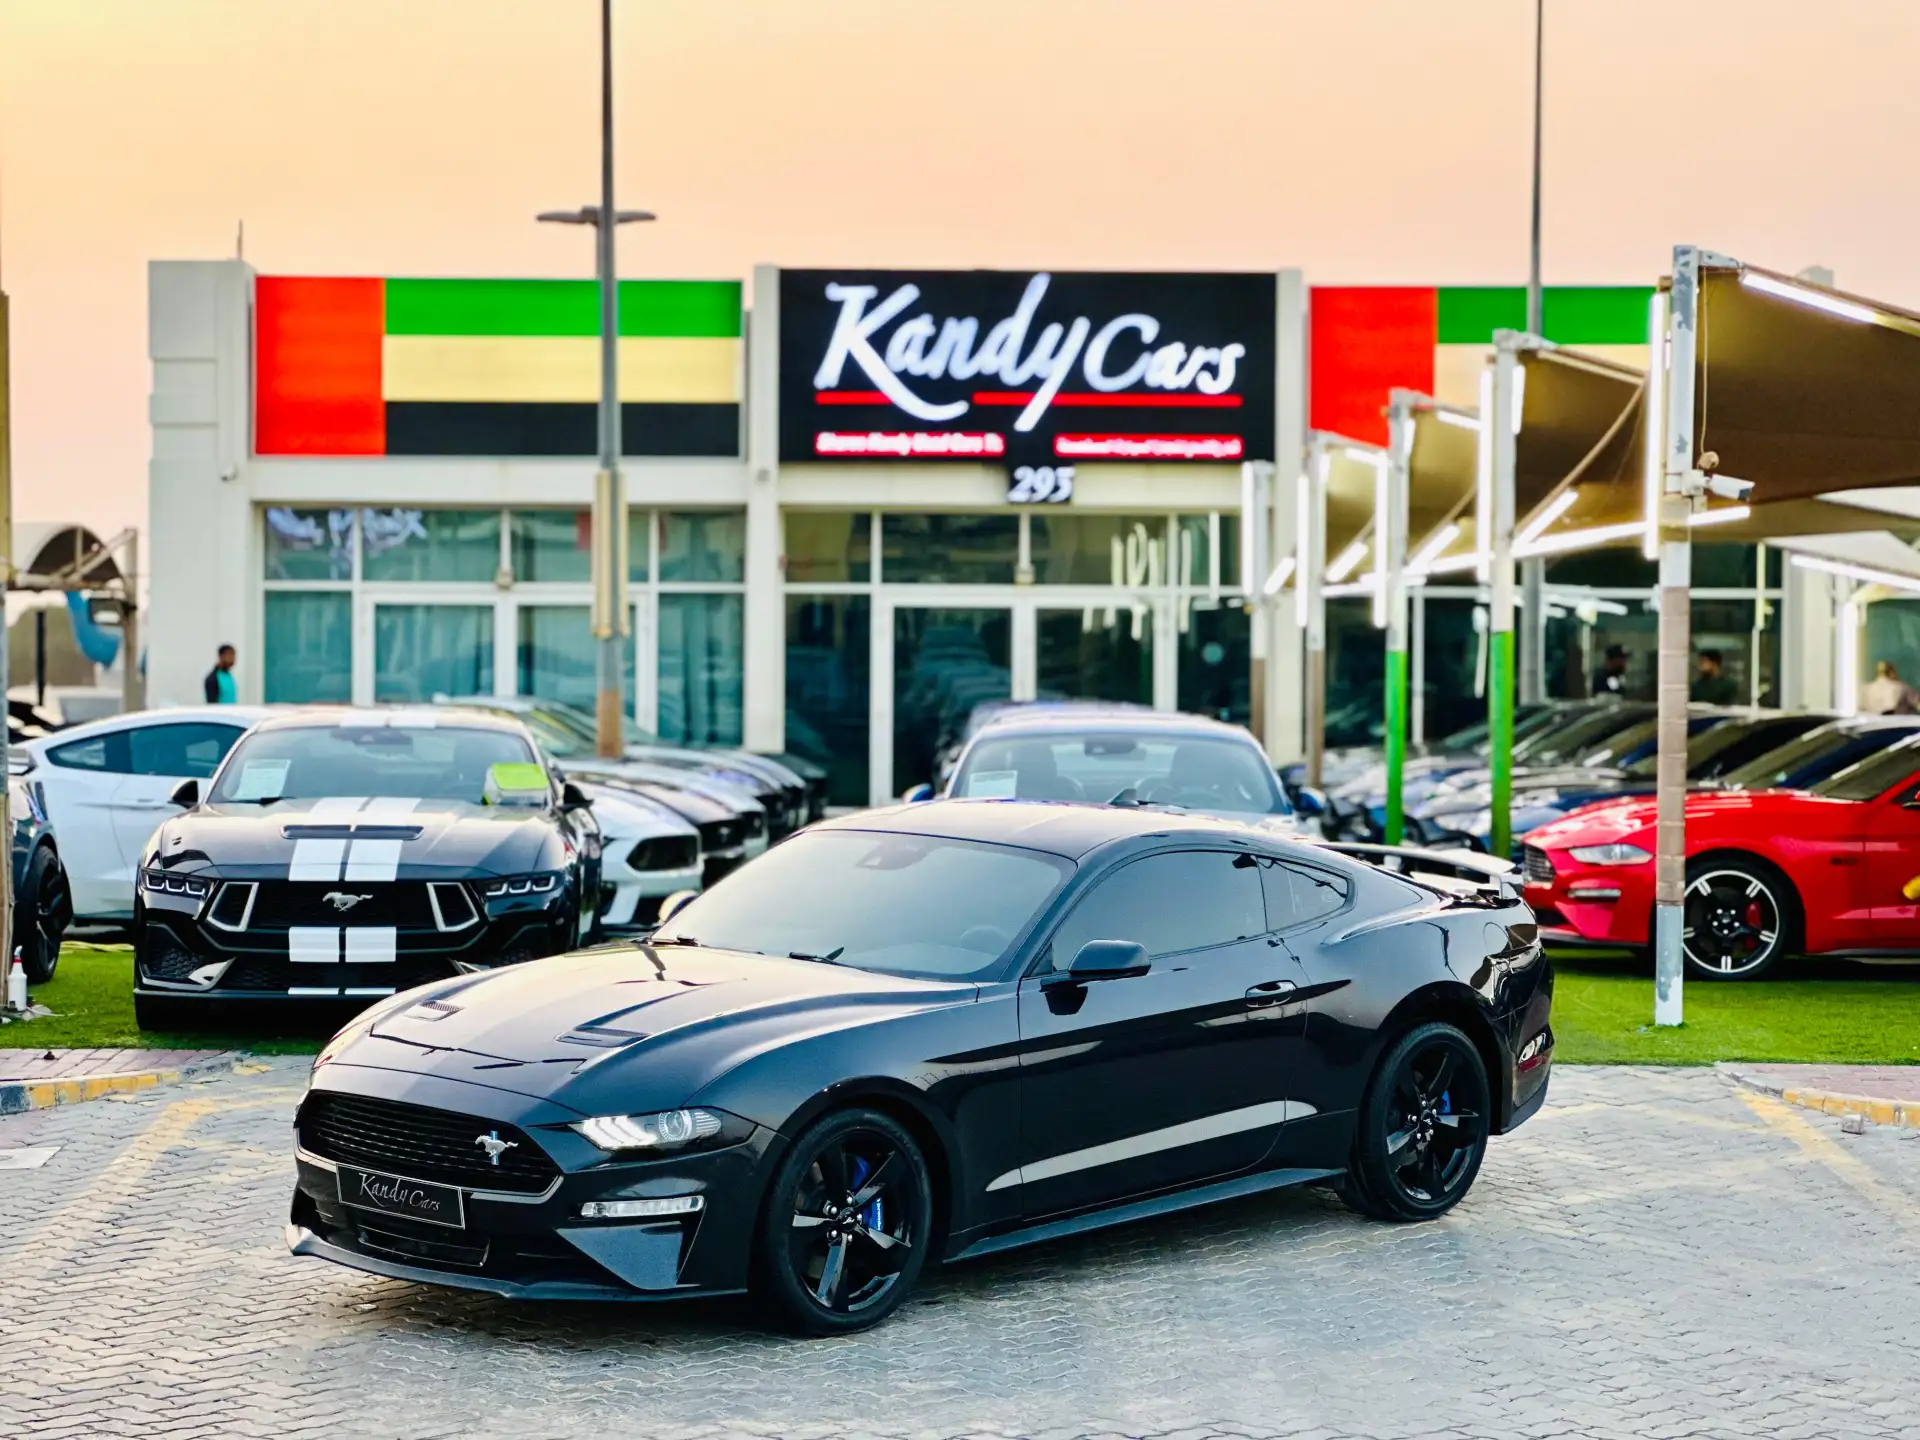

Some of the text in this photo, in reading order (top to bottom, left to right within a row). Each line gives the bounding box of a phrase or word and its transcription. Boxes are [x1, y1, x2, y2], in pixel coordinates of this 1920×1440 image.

[813, 272, 1245, 431] Kandy Cars
[1007, 465, 1076, 503] 295
[358, 1172, 441, 1211] Kandy Cars
